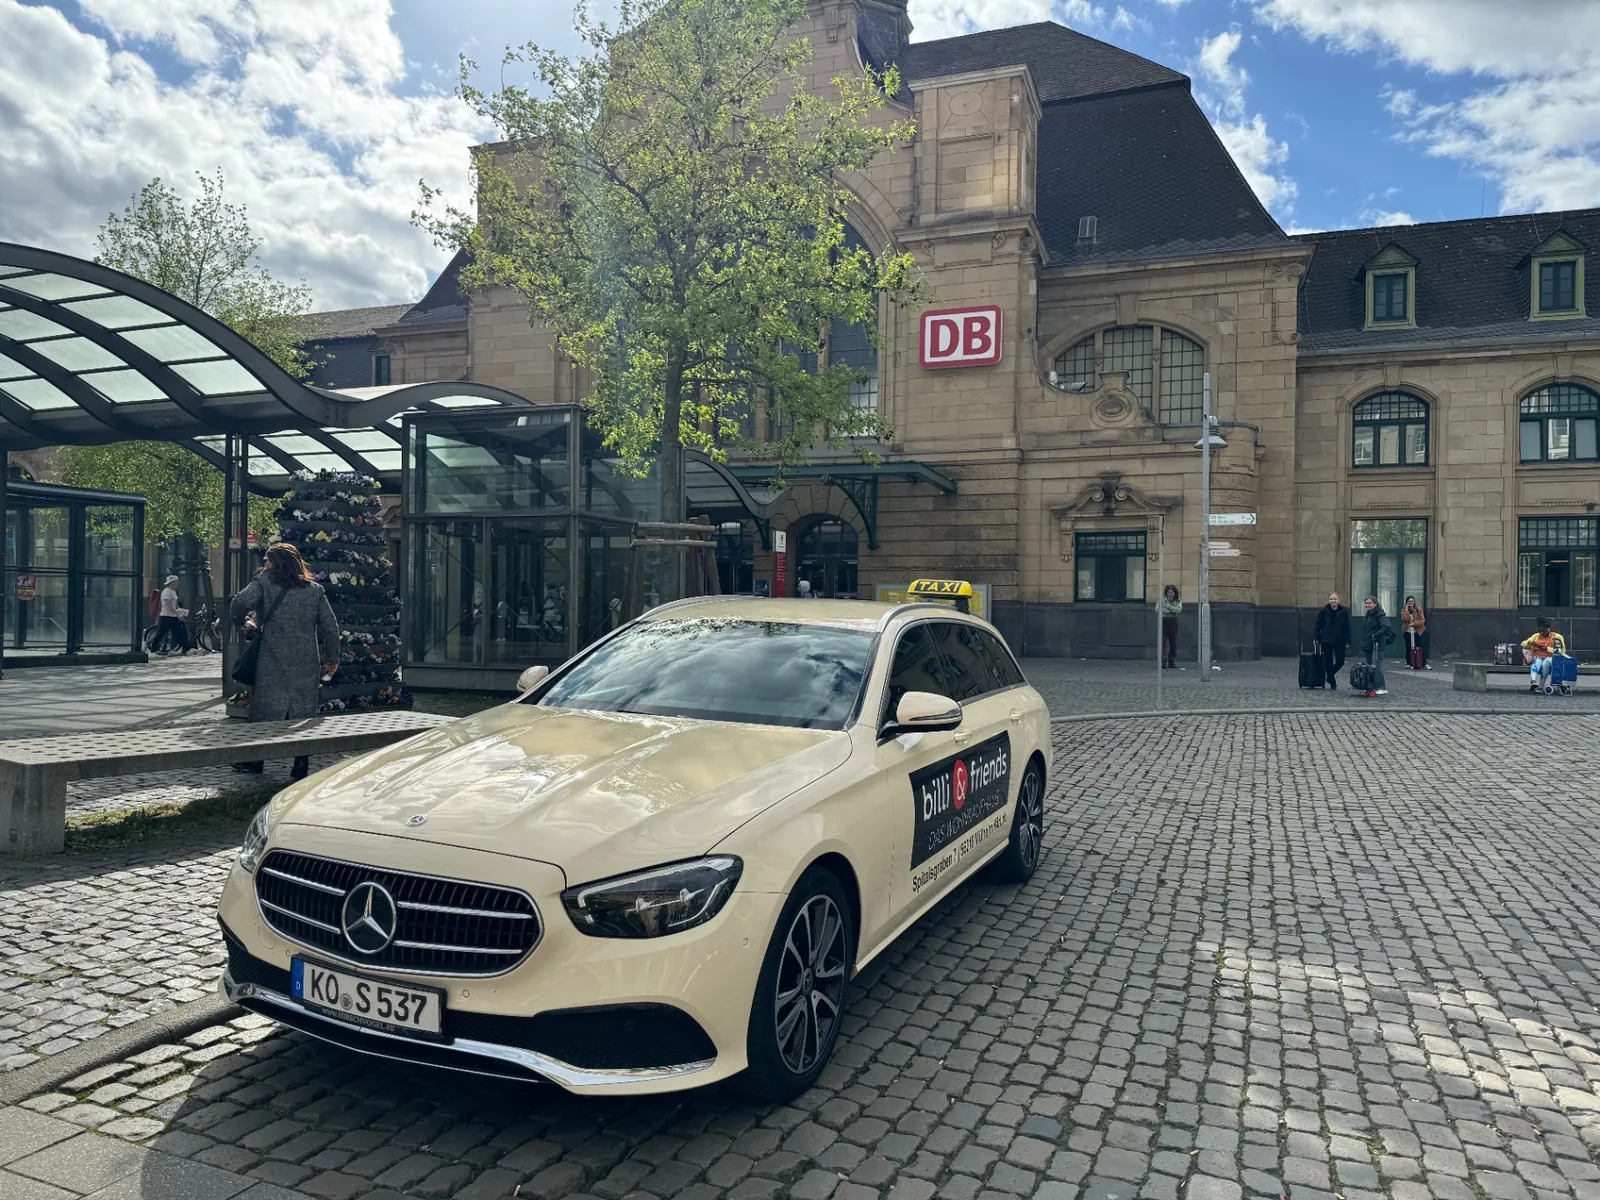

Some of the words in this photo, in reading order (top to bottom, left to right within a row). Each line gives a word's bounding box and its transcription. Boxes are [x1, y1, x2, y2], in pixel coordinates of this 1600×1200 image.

[930, 316, 992, 358] DB
[919, 581, 960, 592] TAXI
[922, 772, 950, 822] billi
[956, 766, 966, 801] &
[970, 747, 1007, 793] friends
[912, 854, 953, 893] Spitalsgraben
[295, 981, 301, 990] D
[311, 968, 339, 1005] KO
[356, 982, 371, 1014] S
[377, 987, 428, 1025] 537
